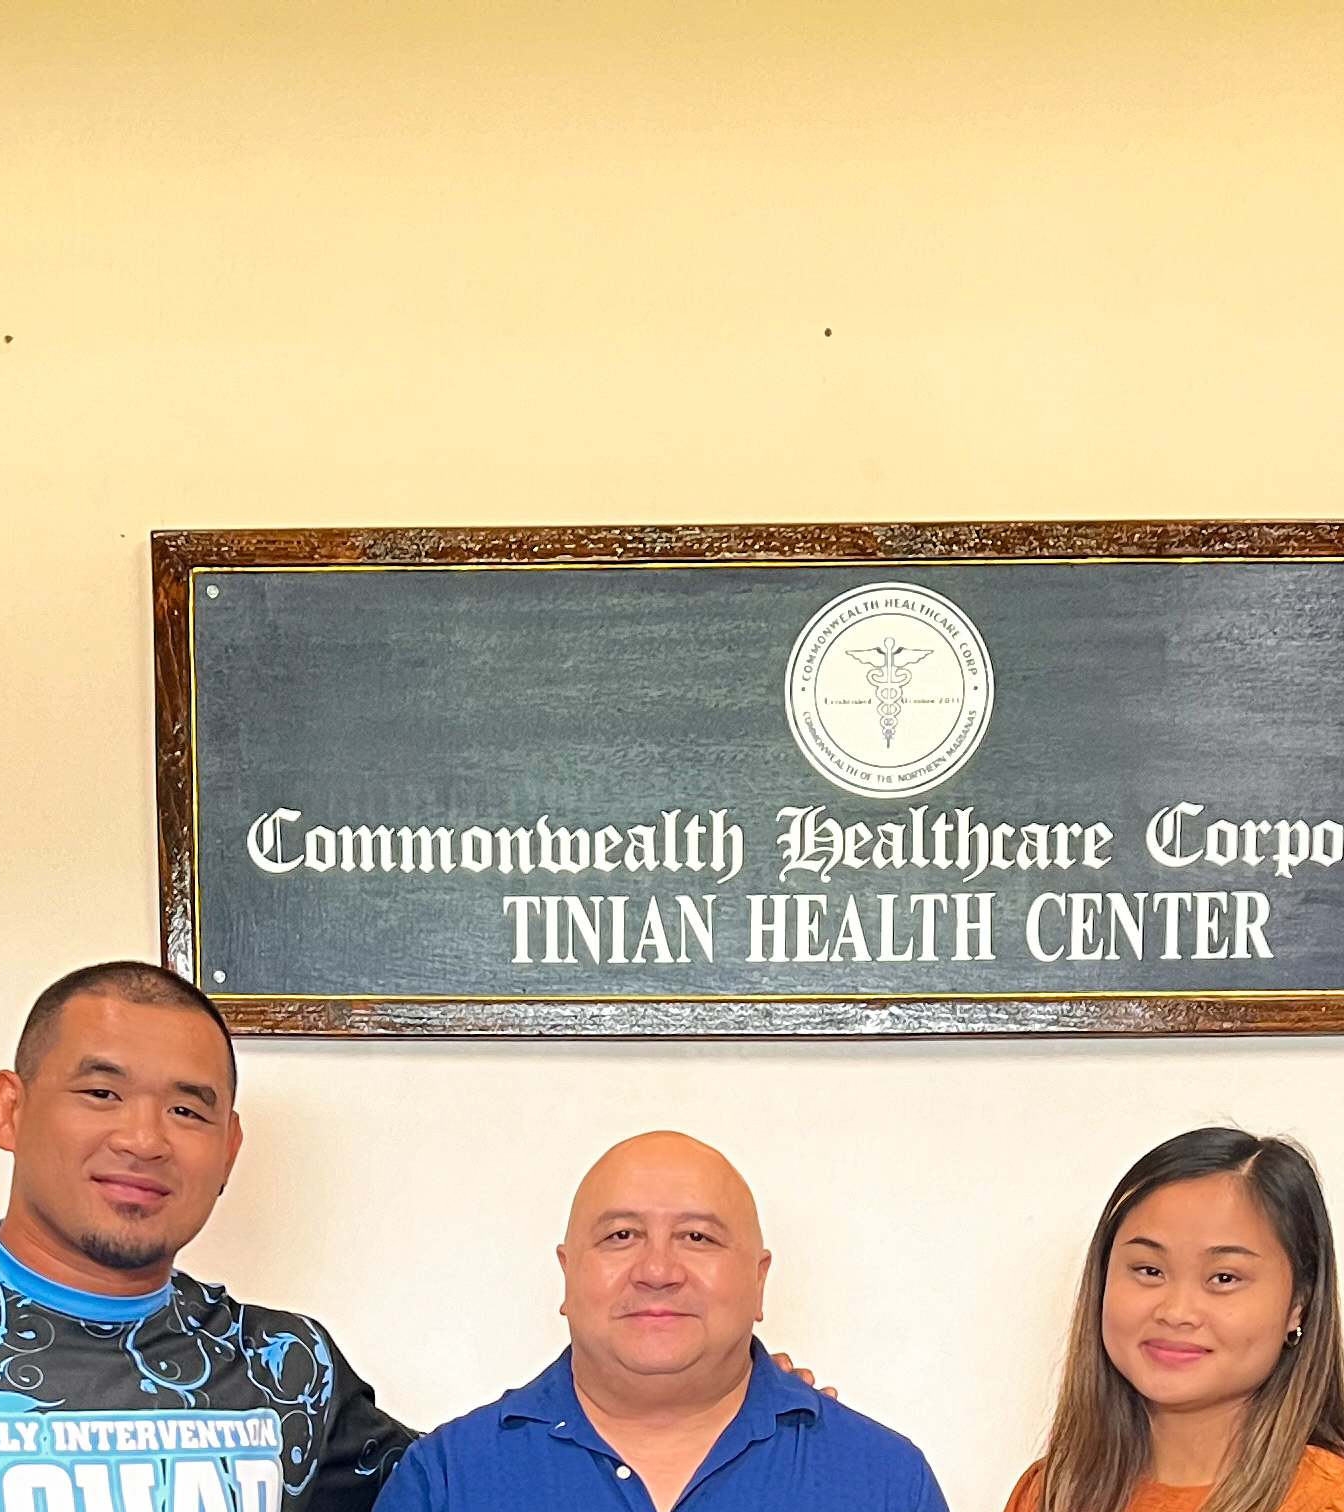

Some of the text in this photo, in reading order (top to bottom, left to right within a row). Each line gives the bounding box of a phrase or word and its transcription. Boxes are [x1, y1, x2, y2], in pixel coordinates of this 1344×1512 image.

[802, 598, 880, 682] COMMONWEALTH
[884, 598, 960, 640] HEALTHCARE
[859, 769, 873, 782] OF
[876, 773, 894, 784] THE
[897, 755, 948, 783] NORTHERN
[246, 804, 745, 886] Commonwealth
[774, 803, 1115, 884] Healthcare
[502, 890, 1276, 966] TINIAN HEALTH CENTER
[50, 1416, 279, 1453] INTERVENTION
